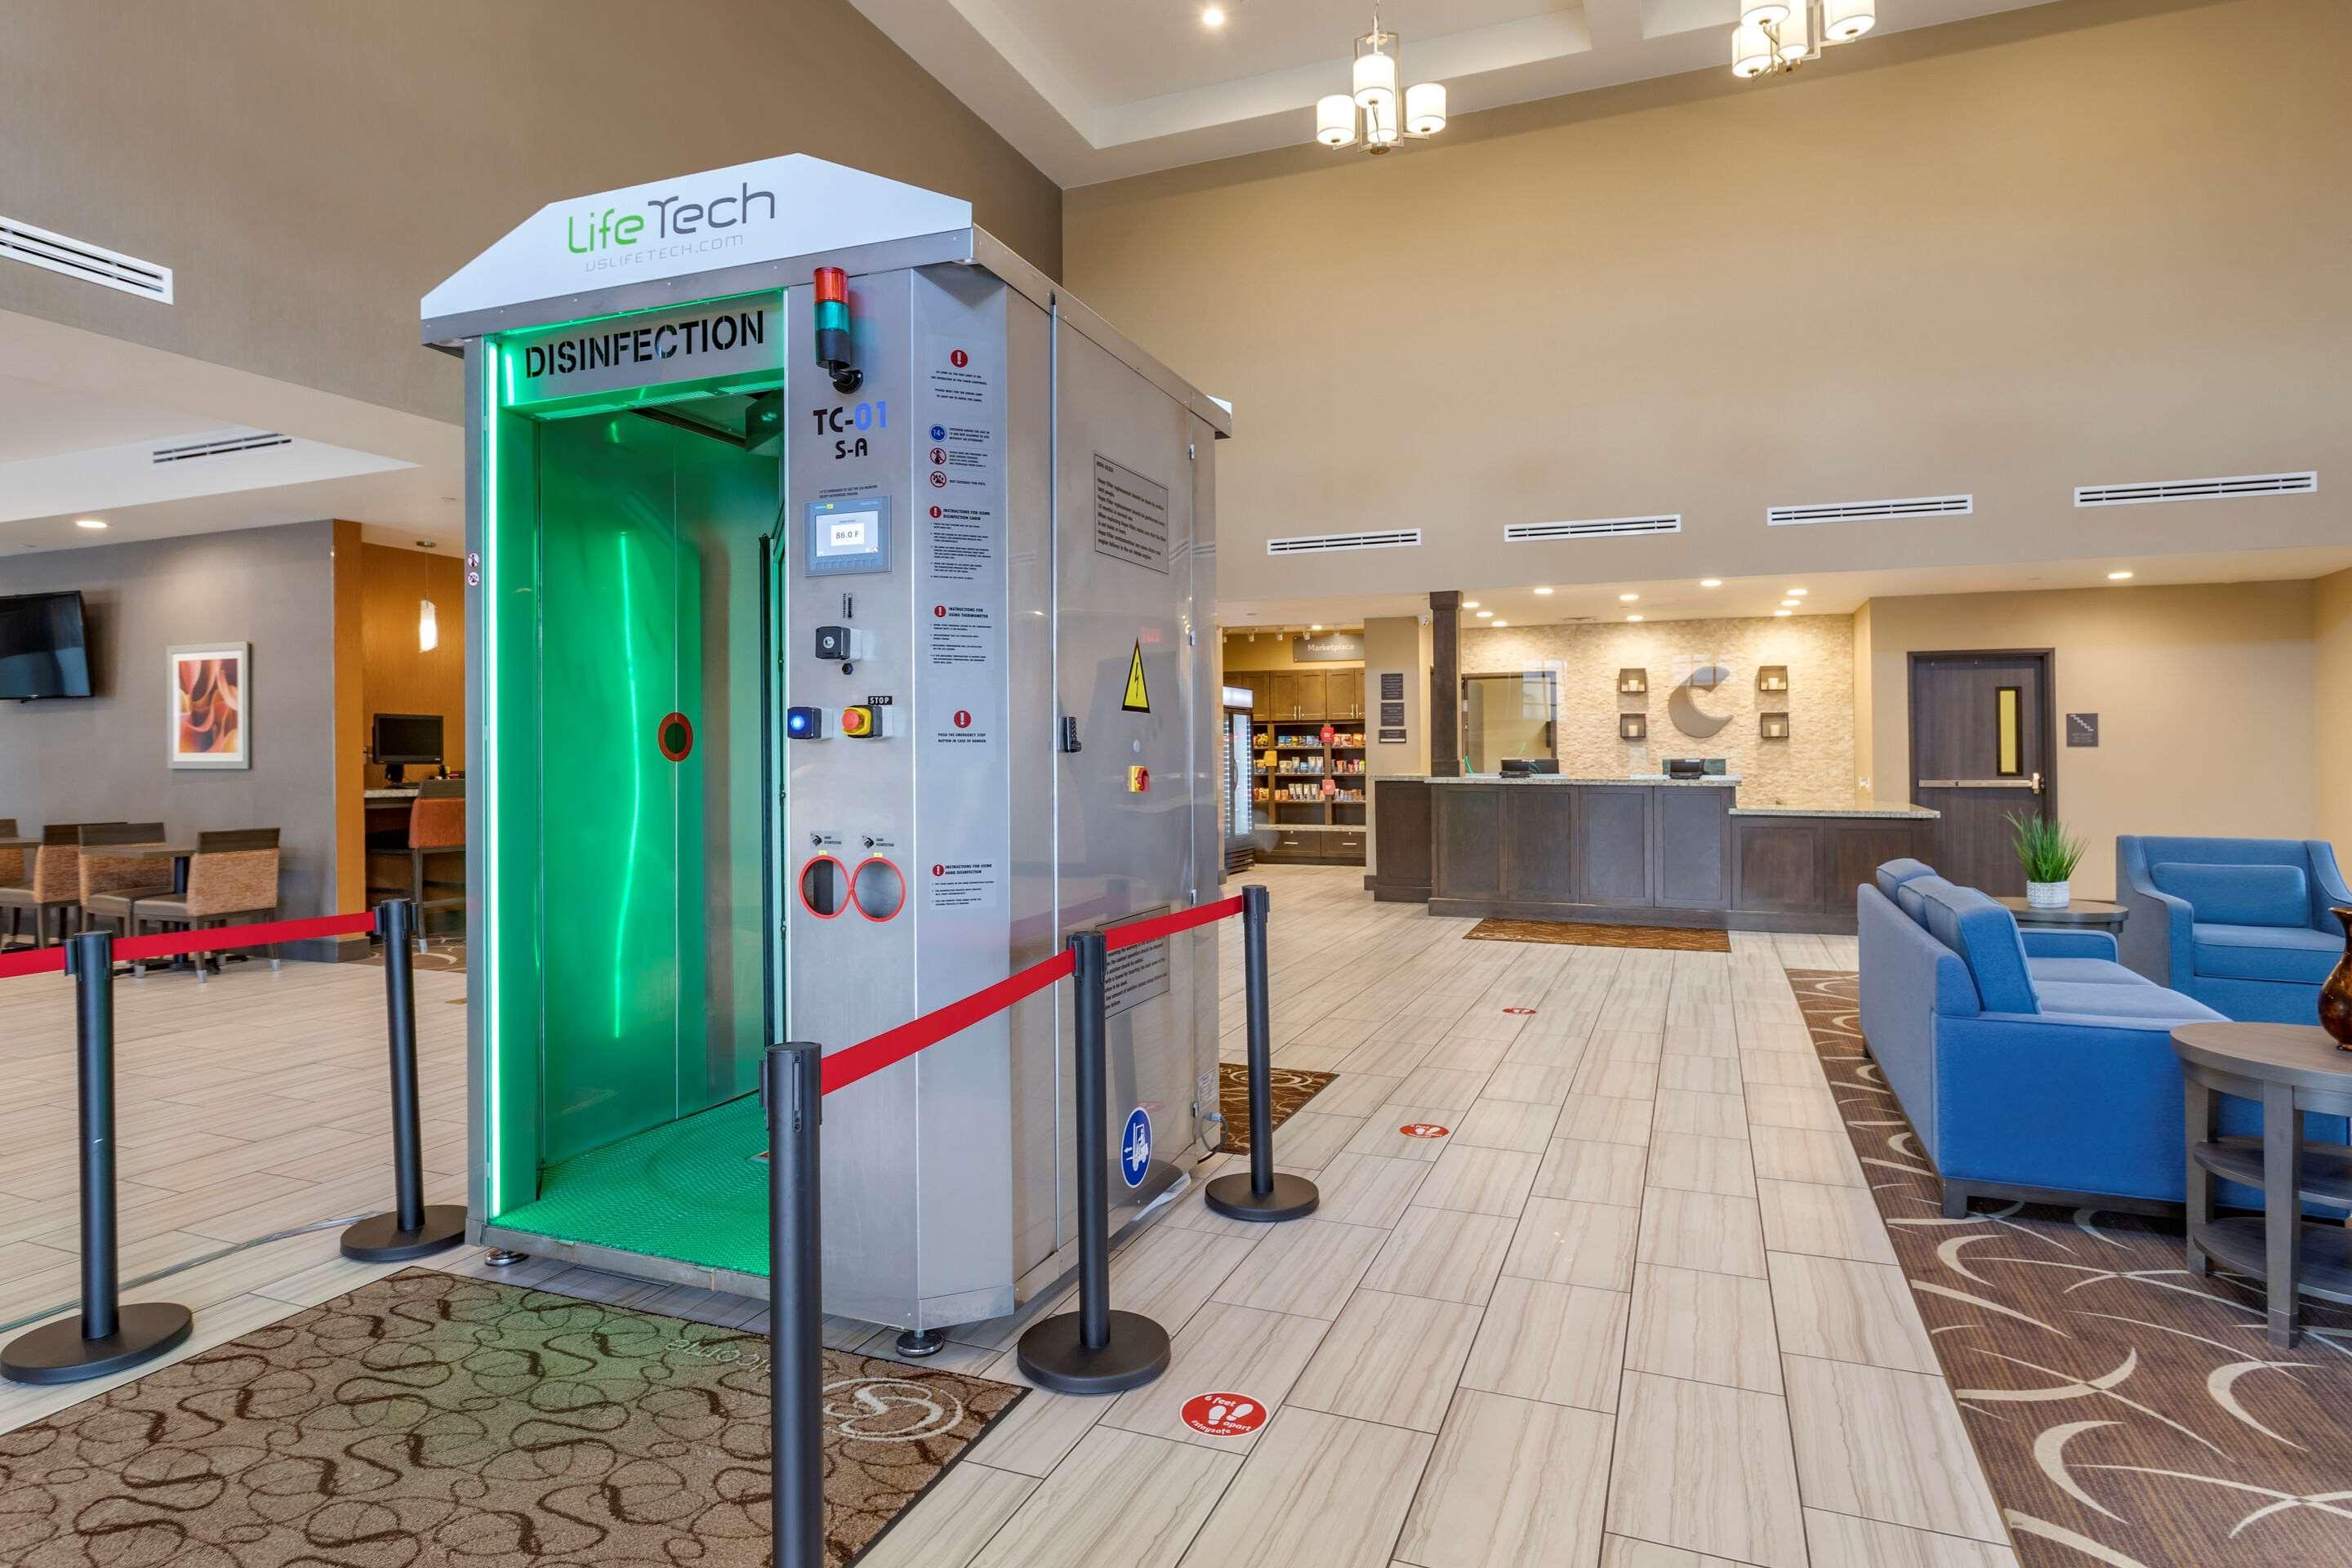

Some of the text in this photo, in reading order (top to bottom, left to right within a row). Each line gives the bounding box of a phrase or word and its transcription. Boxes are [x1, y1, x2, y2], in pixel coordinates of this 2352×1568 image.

[525, 310, 764, 378] DISINFECTION
[813, 400, 887, 435] TC-01
[835, 438, 867, 459] S-A
[1307, 644, 1355, 653] Marketplace
[869, 697, 889, 705] STOP
[1212, 1397, 1237, 1406] feet
[1223, 1421, 1253, 1432] apart
